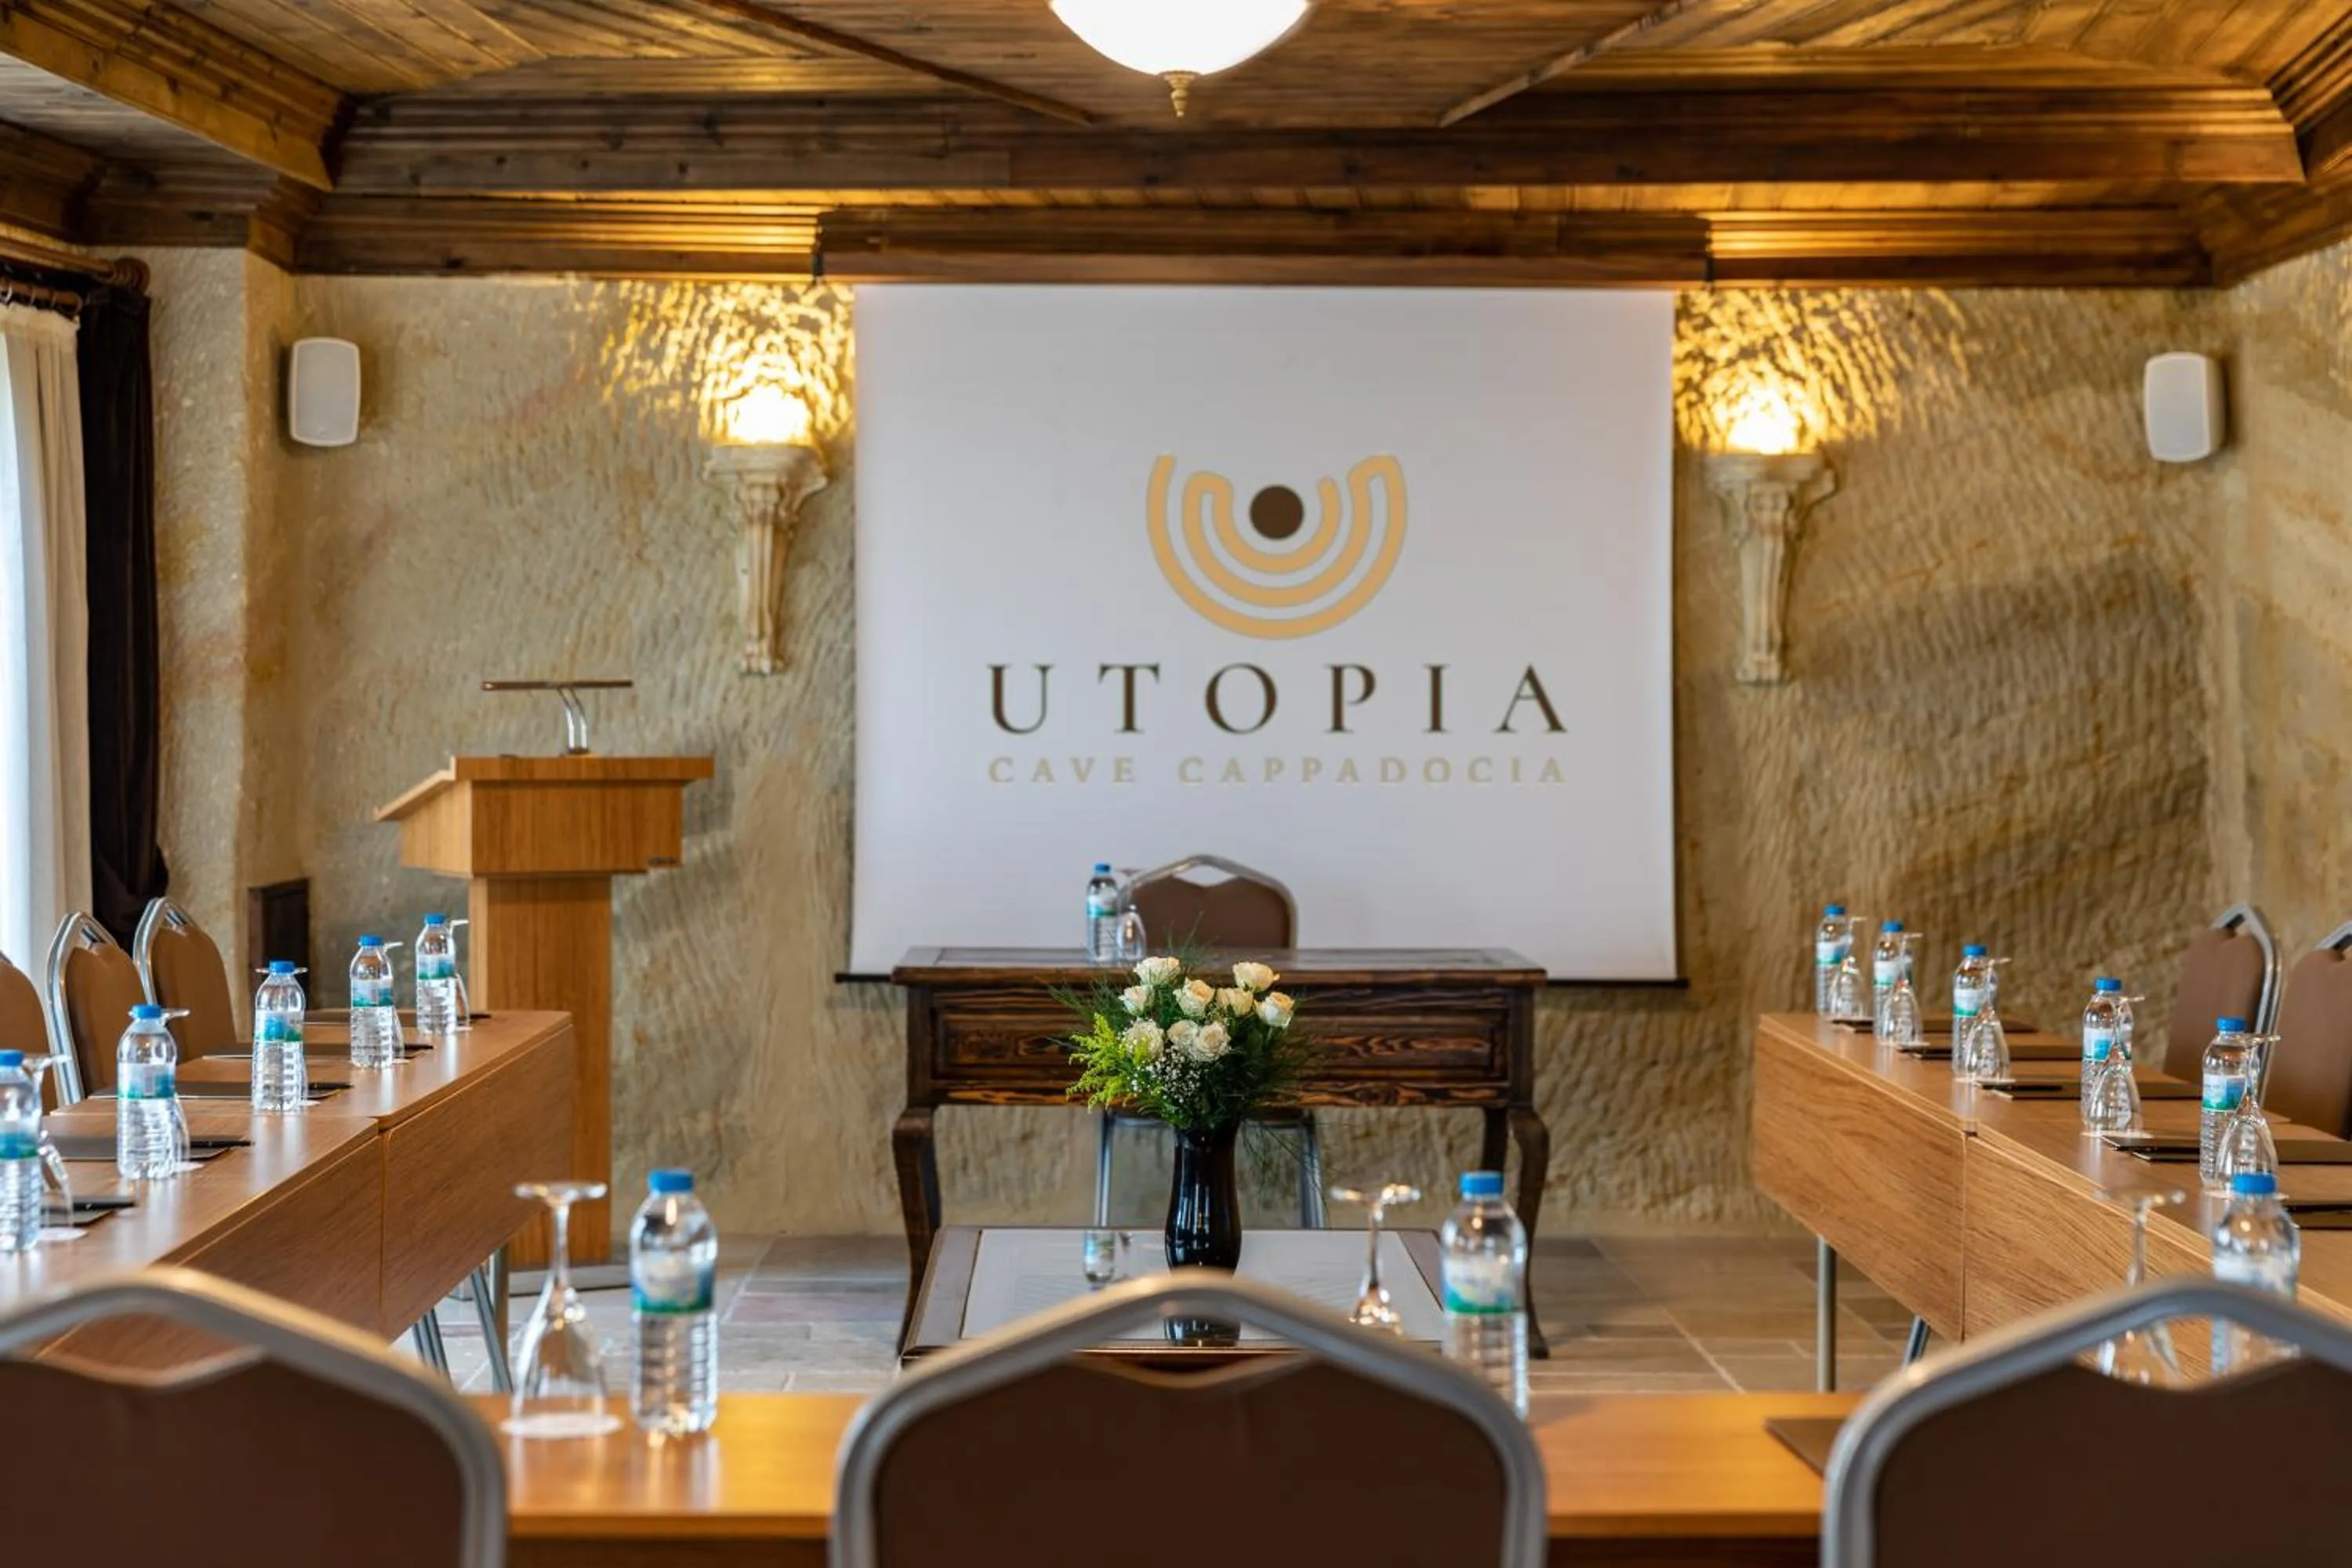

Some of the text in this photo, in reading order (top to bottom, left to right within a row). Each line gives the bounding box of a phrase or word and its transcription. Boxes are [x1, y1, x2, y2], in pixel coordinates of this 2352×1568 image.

[988, 663, 1567, 735] UTOPIA
[989, 757, 1566, 782] CAVE CAPPADOCIA
